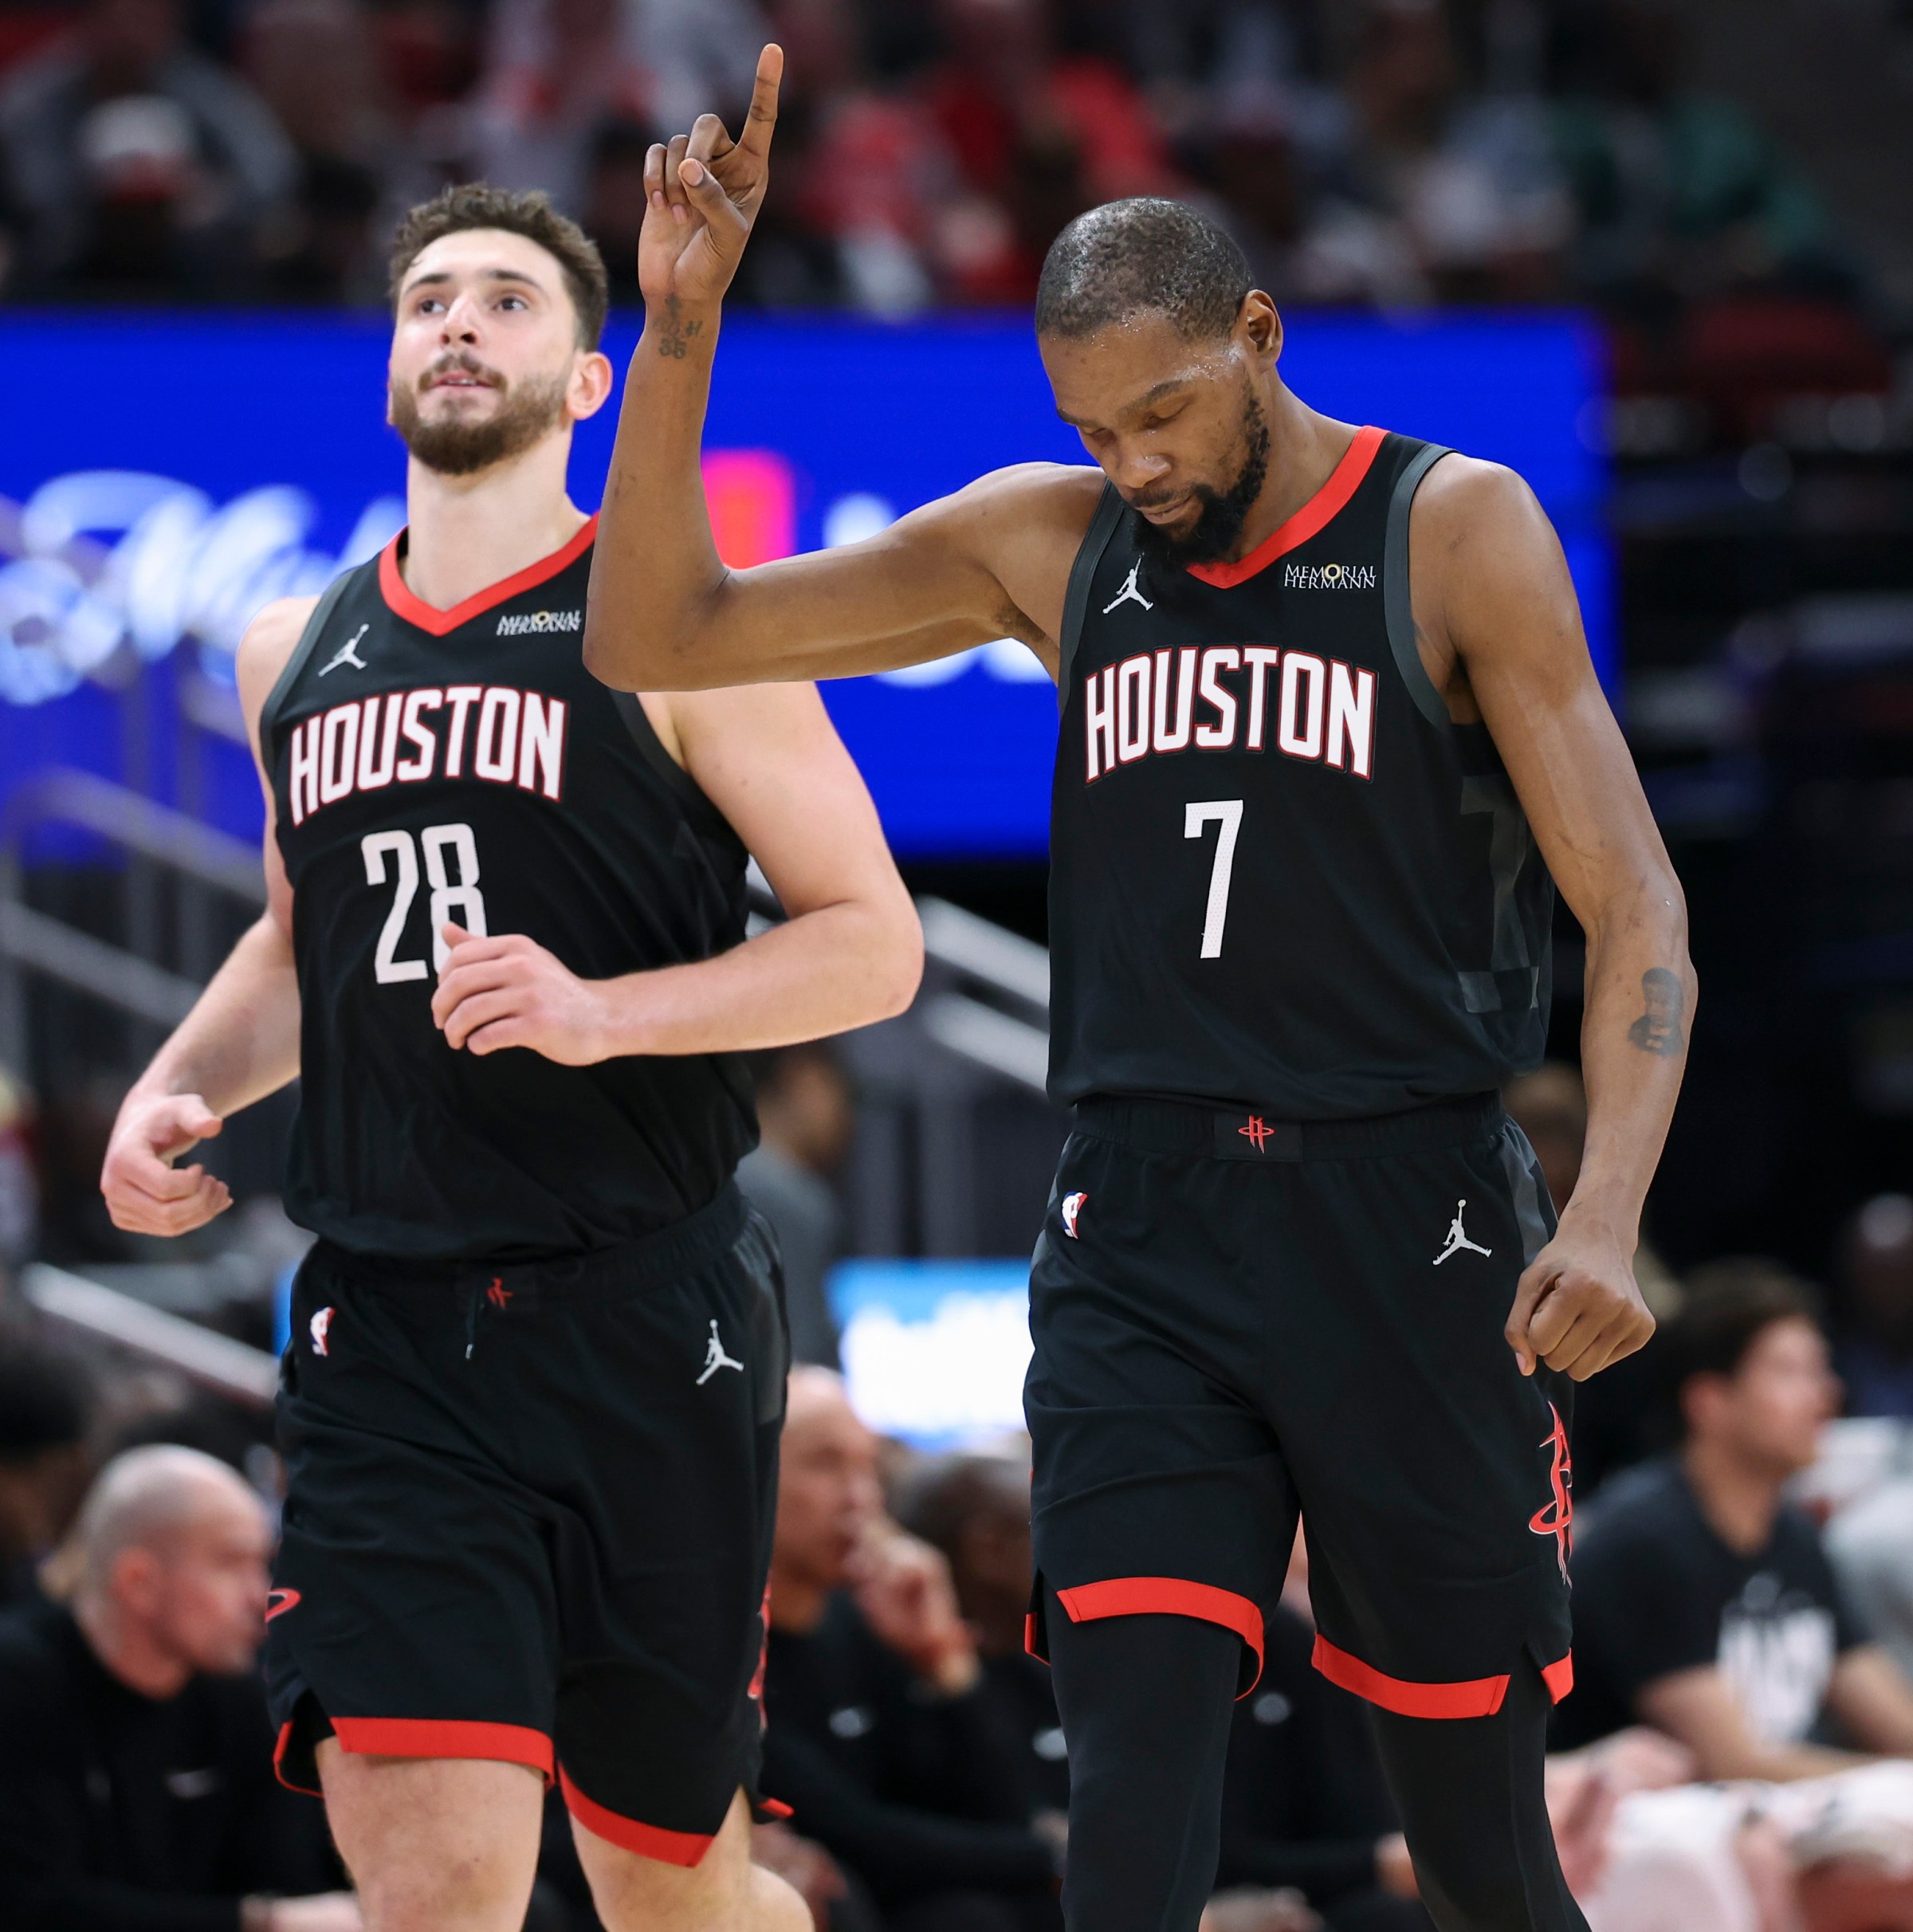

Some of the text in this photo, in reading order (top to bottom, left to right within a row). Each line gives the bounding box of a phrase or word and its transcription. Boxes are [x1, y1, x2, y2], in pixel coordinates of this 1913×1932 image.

[1283, 574, 1376, 590] HERMANN
[1284, 563, 1377, 580] MEMORIAL
[289, 684, 568, 829] HOUSTON
[1085, 645, 1379, 783] HOUSTON
[360, 823, 488, 985] 28
[1184, 799, 1244, 960] 7
